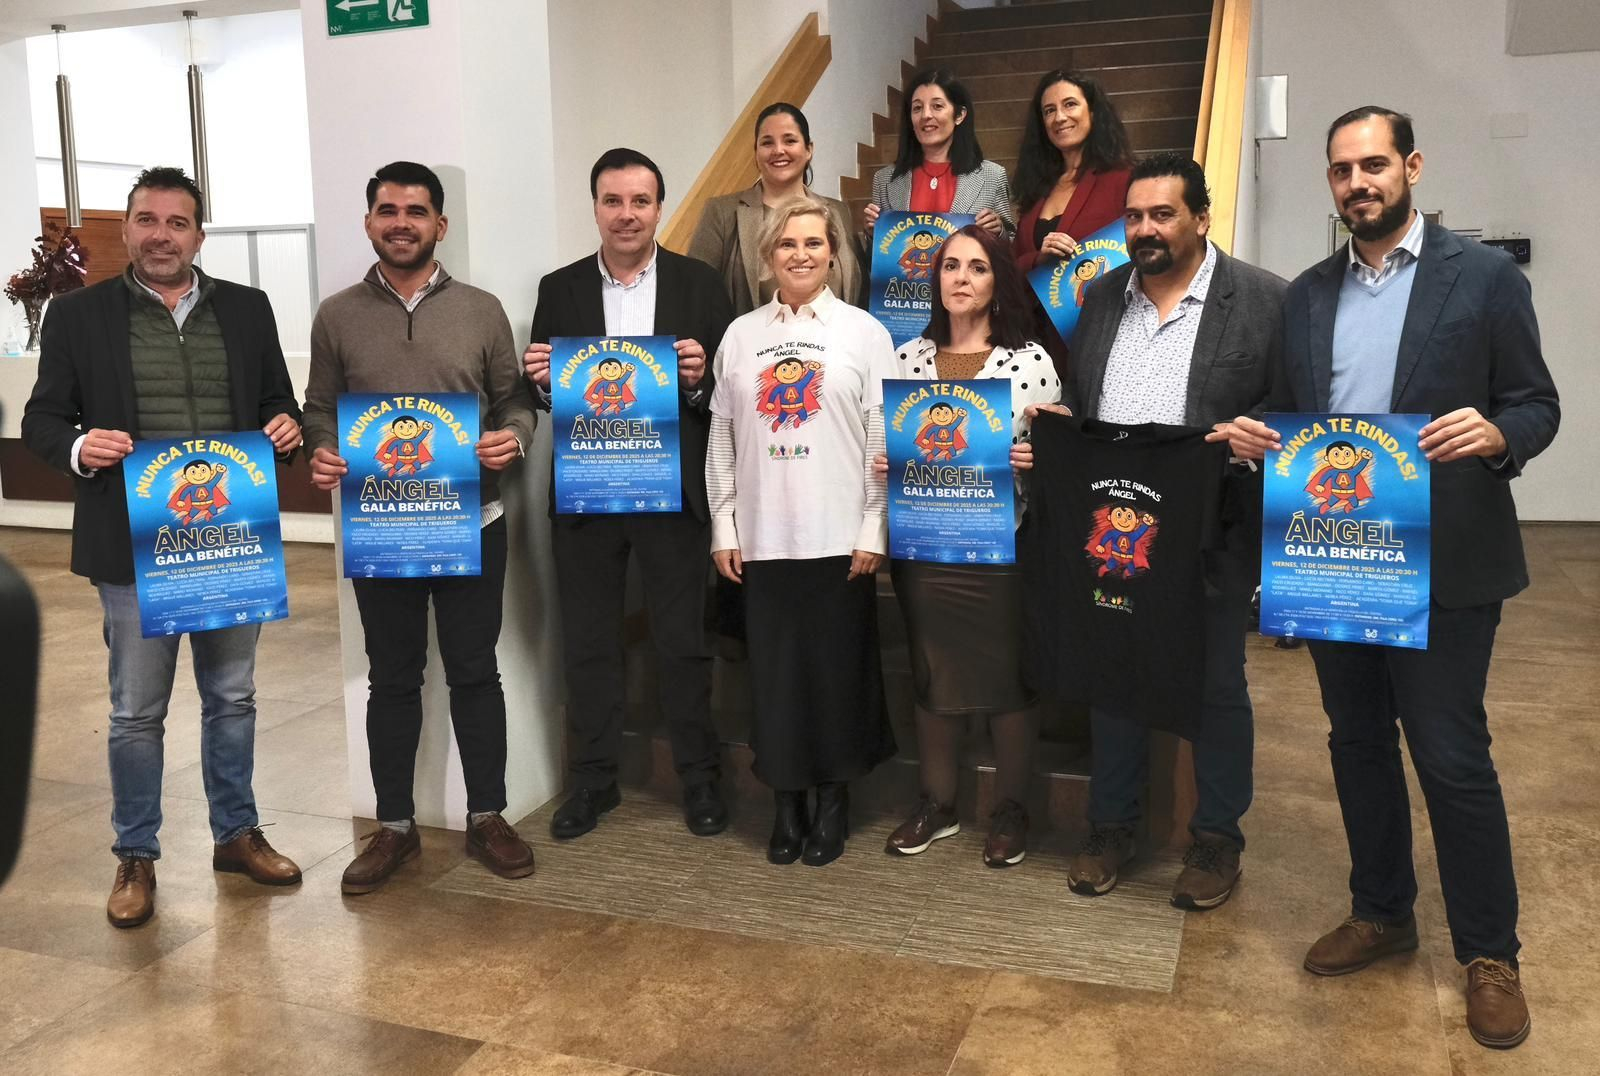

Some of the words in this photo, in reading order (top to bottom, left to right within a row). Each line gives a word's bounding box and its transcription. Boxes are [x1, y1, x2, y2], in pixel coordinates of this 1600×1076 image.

[916, 215, 932, 224] TE
[1085, 239, 1128, 256] RINDA
[884, 277, 932, 300] ÁNG
[884, 300, 910, 308] GALA
[756, 344, 783, 357] NUNCA
[797, 342, 826, 351] RINDAS
[558, 344, 599, 389] ¡NUNCA
[599, 340, 619, 352] TE
[621, 341, 670, 388] RINDAS!
[609, 384, 618, 392] A
[787, 388, 796, 399] A
[891, 387, 930, 432] ¡NUNCA
[930, 383, 950, 395] TE
[952, 385, 1003, 433] RINDAS!
[347, 401, 392, 448] ¡NUNCA
[393, 397, 414, 409] TE
[417, 398, 471, 446] RINDAS!
[571, 414, 660, 440] ÁNGEL
[940, 430, 947, 438] A
[404, 443, 412, 452] A
[571, 441, 603, 450] GALA
[605, 438, 662, 450] BENÉFICA
[1276, 423, 1327, 477] ¡NUNCA
[1327, 418, 1352, 432] TE
[1355, 420, 1418, 481] RINDAS!
[136, 447, 182, 498] ¡NUNCA
[183, 440, 206, 454] TE
[209, 440, 267, 486] RINDAS!
[903, 459, 992, 487] ÁNGEL
[360, 475, 459, 501] ÁNGEL
[1339, 475, 1348, 486] A
[197, 489, 207, 497] A
[903, 486, 934, 497] GALA
[936, 486, 995, 498] BENÉFICA
[1091, 480, 1118, 490] NUNCA
[1120, 480, 1131, 488] TE
[1132, 482, 1162, 502] RINDAS
[360, 503, 396, 512] GALA
[398, 500, 461, 512] BENÉFICA
[154, 521, 259, 554] ÁNGEL
[1285, 510, 1403, 548] ÁNGEL
[1120, 537, 1128, 547] A
[156, 553, 194, 565] GALA
[196, 545, 263, 561] BENÉFICA
[1285, 544, 1327, 557] GALA
[1330, 542, 1406, 563] BENÉFICA
